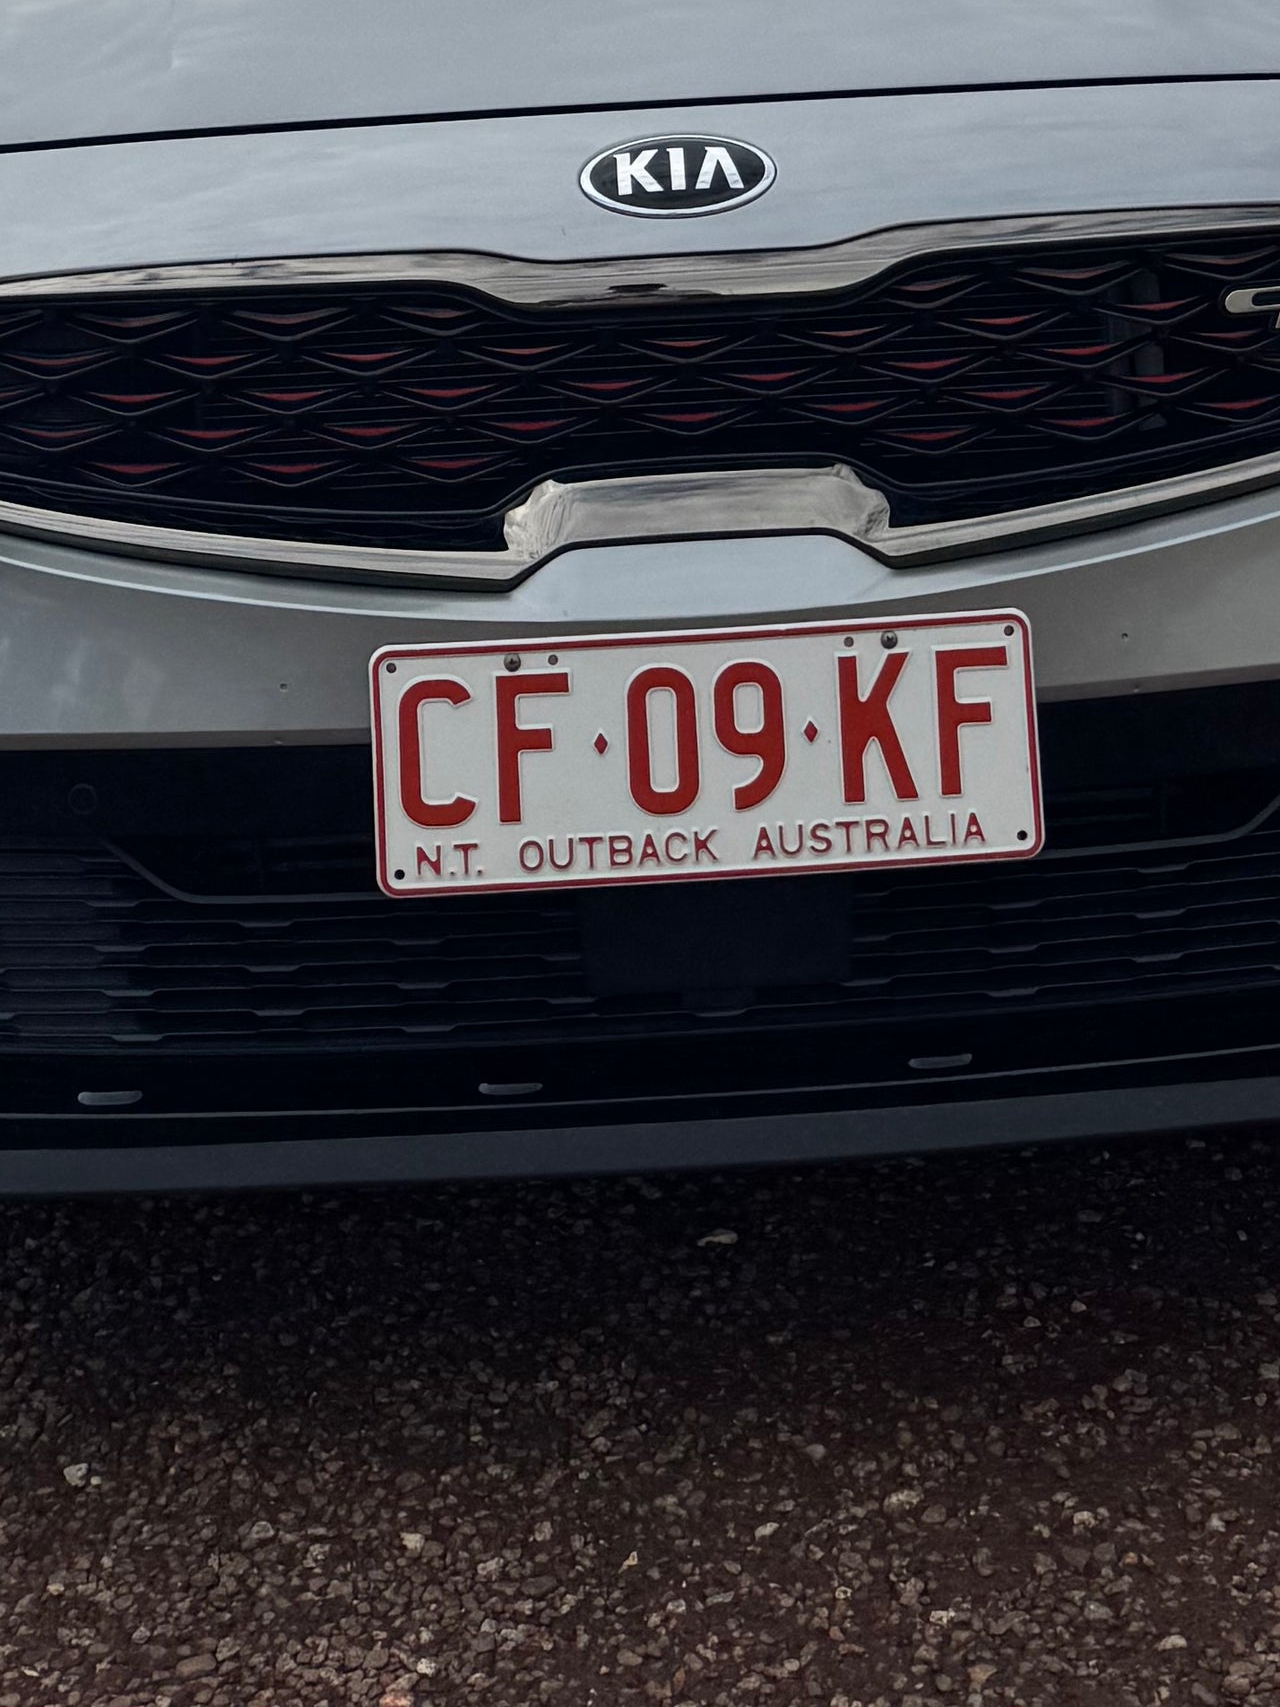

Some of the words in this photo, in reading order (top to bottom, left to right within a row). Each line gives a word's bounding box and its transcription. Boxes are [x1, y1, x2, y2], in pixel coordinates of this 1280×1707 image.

[613, 146, 745, 196] KIA
[415, 843, 484, 877] N.T.
[519, 828, 719, 872] OUTBACK
[753, 812, 986, 860] AUSTRALIA
